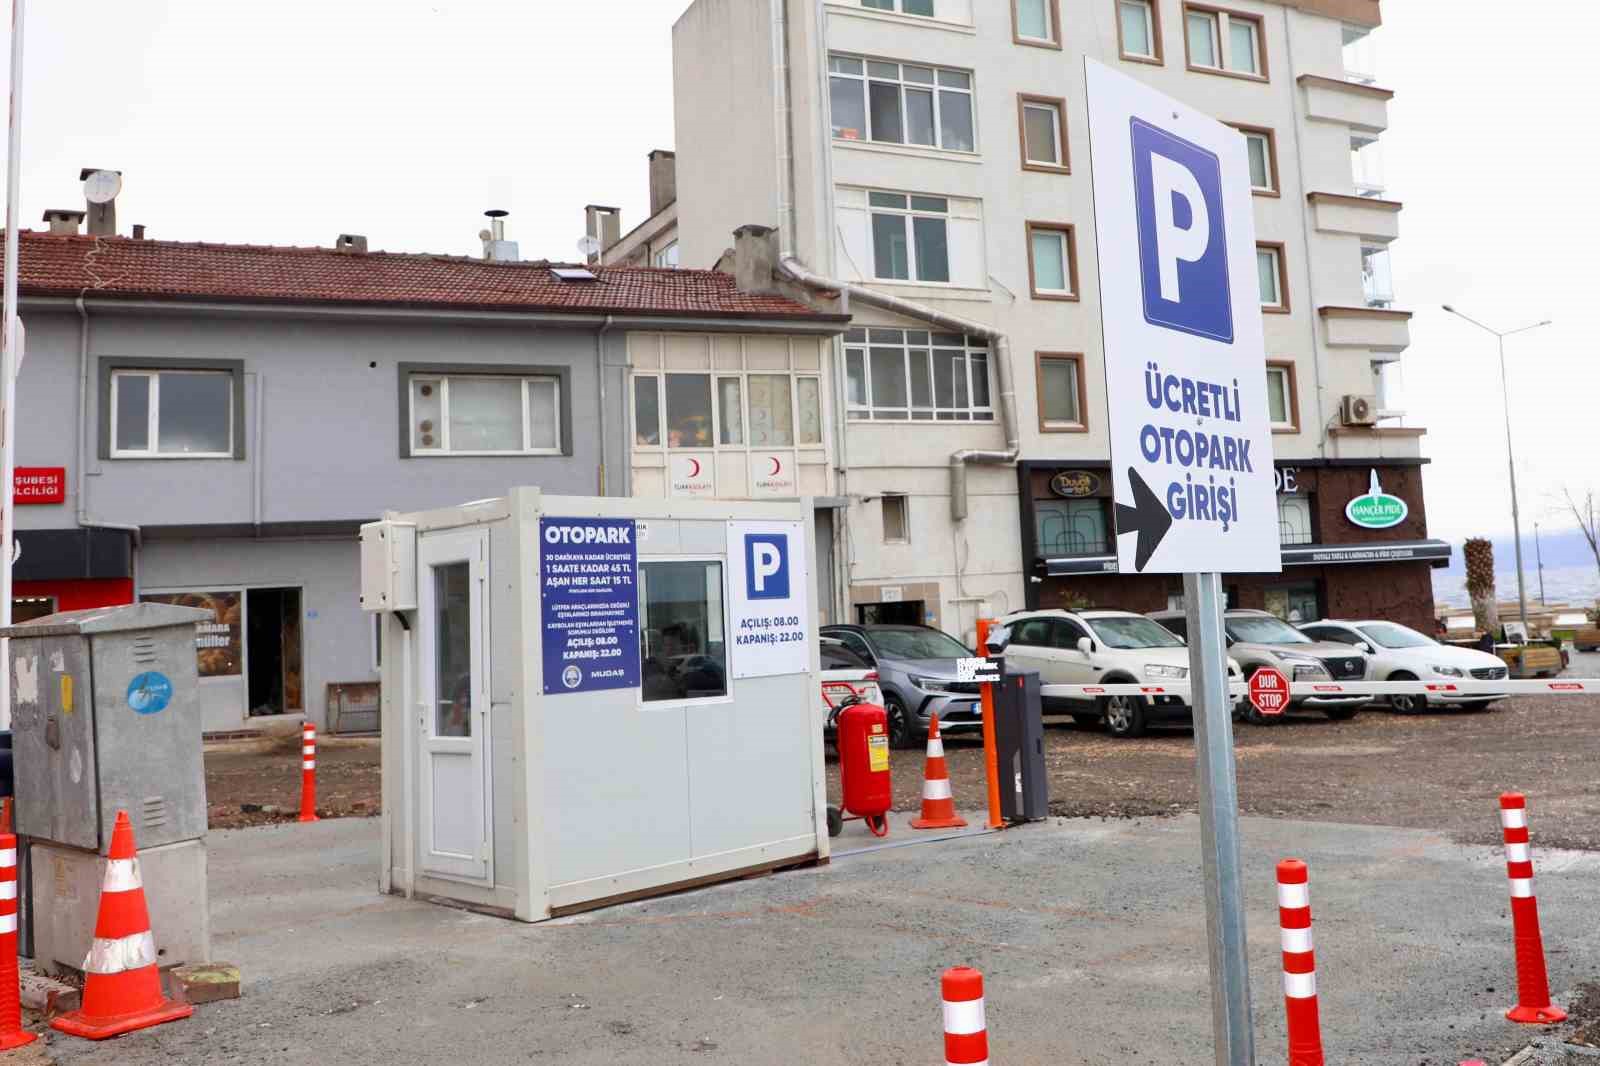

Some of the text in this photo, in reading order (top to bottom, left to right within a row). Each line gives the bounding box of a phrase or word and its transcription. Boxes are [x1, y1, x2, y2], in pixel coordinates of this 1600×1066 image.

[1150, 151, 1210, 303] P
[1144, 361, 1240, 422] ÜCRETLİ
[1140, 424, 1253, 473] OTOPARK
[1166, 473, 1238, 533] GİRİŞİ
[545, 526, 631, 544] OTOPARK
[552, 564, 579, 573] SAATE
[580, 564, 609, 573] KADAR
[623, 564, 632, 572] TL
[752, 542, 781, 592] P
[546, 576, 632, 587] AŞAN HER SAAT 15 TL
[740, 616, 799, 629] AÇILIŞ: 08.00
[779, 631, 803, 642] 22.00
[1258, 675, 1278, 689] DUR
[1259, 693, 1282, 707] STOP
